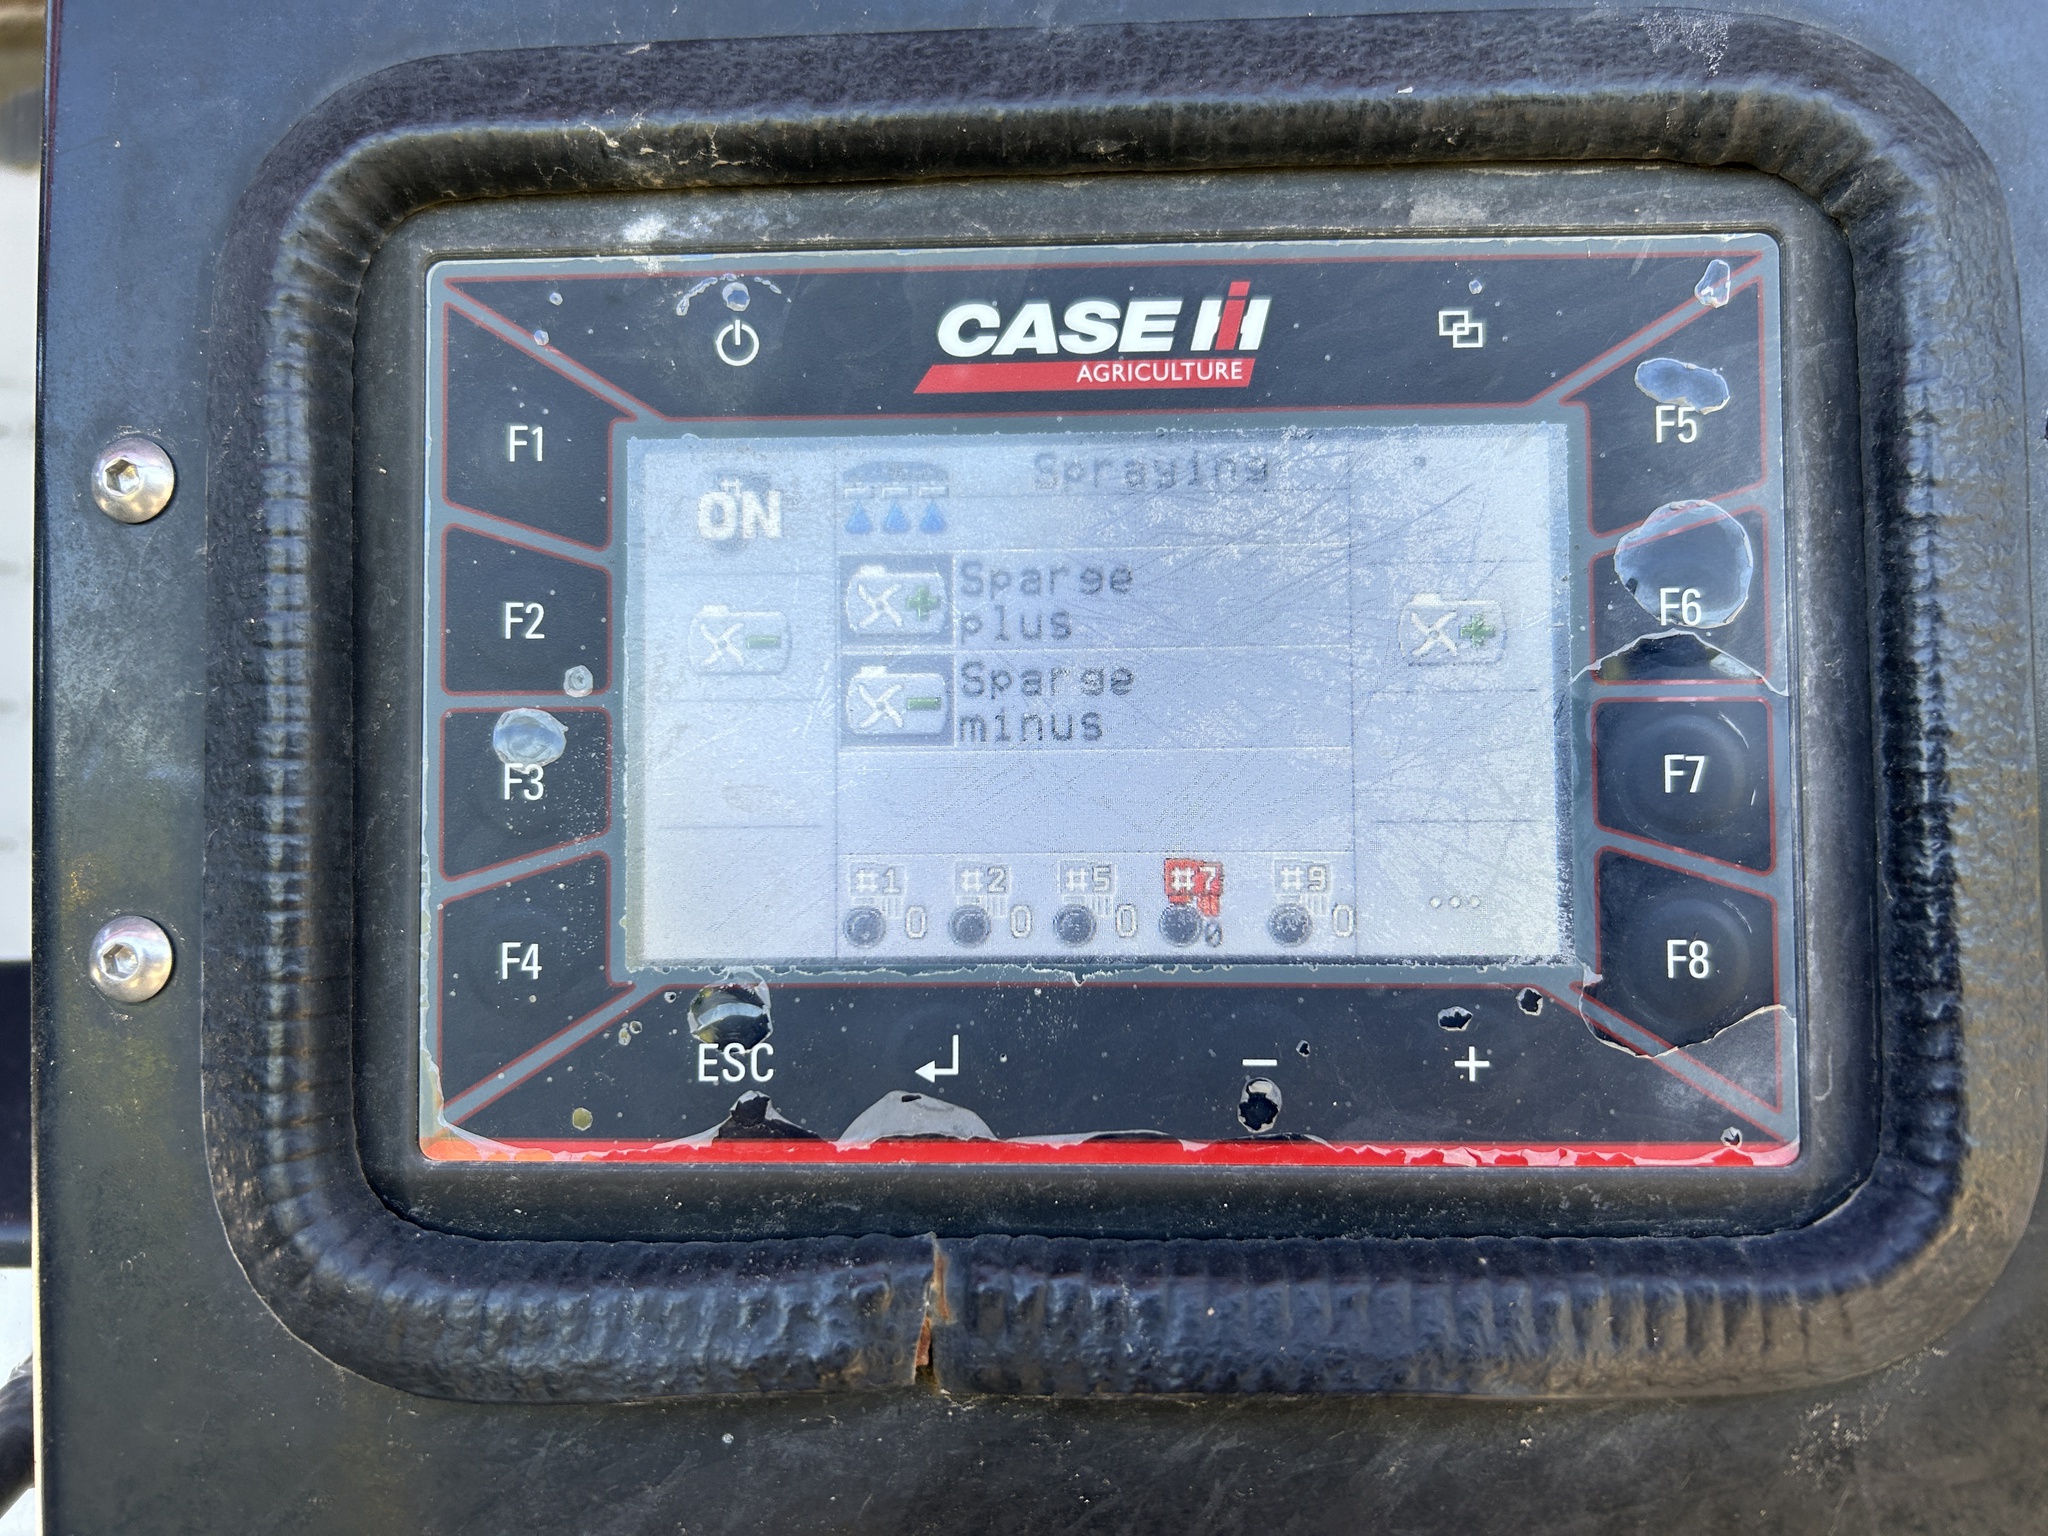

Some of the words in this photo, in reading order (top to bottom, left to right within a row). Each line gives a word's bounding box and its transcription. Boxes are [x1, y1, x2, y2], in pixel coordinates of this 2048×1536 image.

[937, 299, 1182, 357] CASE
[1076, 361, 1244, 383] AGRICULTURE
[1655, 405, 1697, 443] F5
[508, 425, 543, 462] F1
[1033, 451, 1269, 490] Spraying
[699, 489, 782, 540] ON
[959, 560, 1133, 599] Sparge
[504, 602, 545, 640] F2
[959, 604, 1072, 643] plus
[1659, 587, 1702, 626] F6
[959, 661, 1134, 699] Sparge
[959, 709, 1103, 742] minus
[503, 762, 545, 800] F3
[1663, 754, 1706, 793] F7
[855, 867, 900, 895] #1
[960, 866, 1007, 894] #2
[1065, 865, 1111, 893] #5
[1171, 865, 1218, 893] #7
[1279, 864, 1327, 892] #9
[904, 905, 928, 940] 0
[1010, 904, 1033, 939] 0
[1115, 902, 1139, 938] 0
[1331, 903, 1356, 938] 0
[500, 942, 542, 981] F4
[1666, 939, 1710, 979] F8
[697, 1042, 775, 1083] ESC
